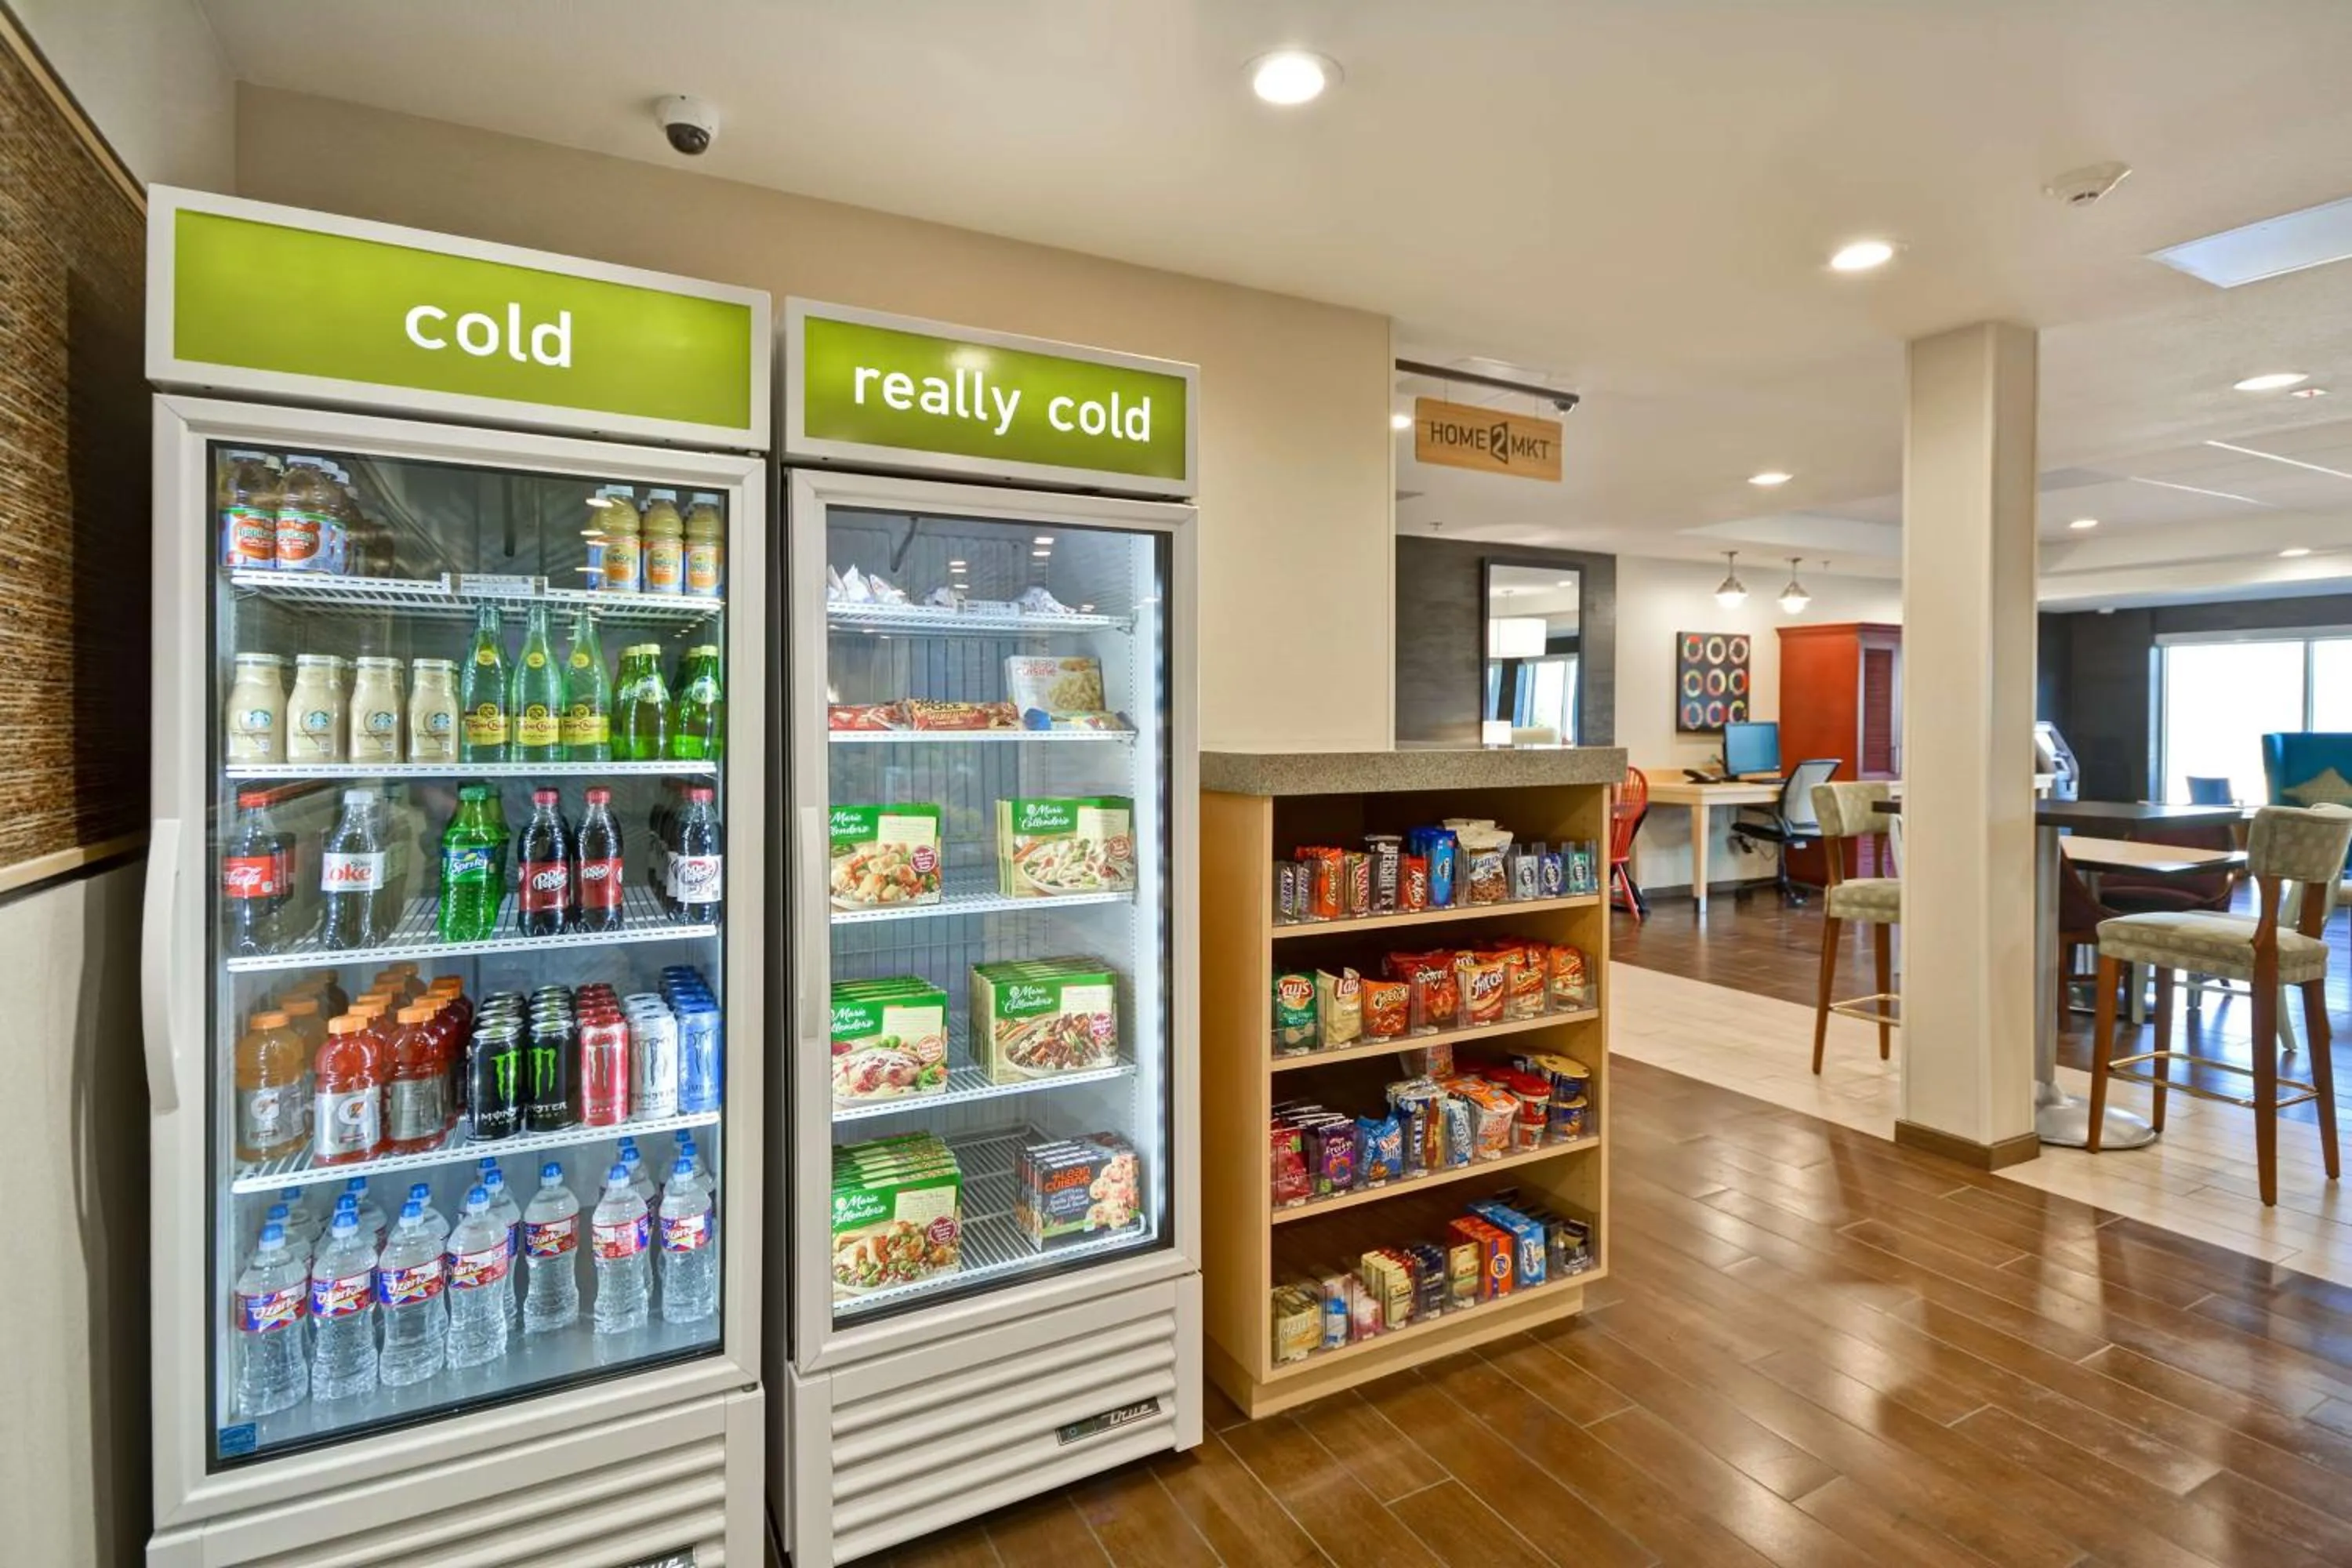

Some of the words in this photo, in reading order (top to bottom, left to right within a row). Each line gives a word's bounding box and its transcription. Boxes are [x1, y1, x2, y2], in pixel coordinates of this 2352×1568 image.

[405, 303, 572, 368] cold
[855, 365, 1021, 436] really
[1048, 391, 1151, 443] cold
[1337, 980, 1359, 997] Lay
